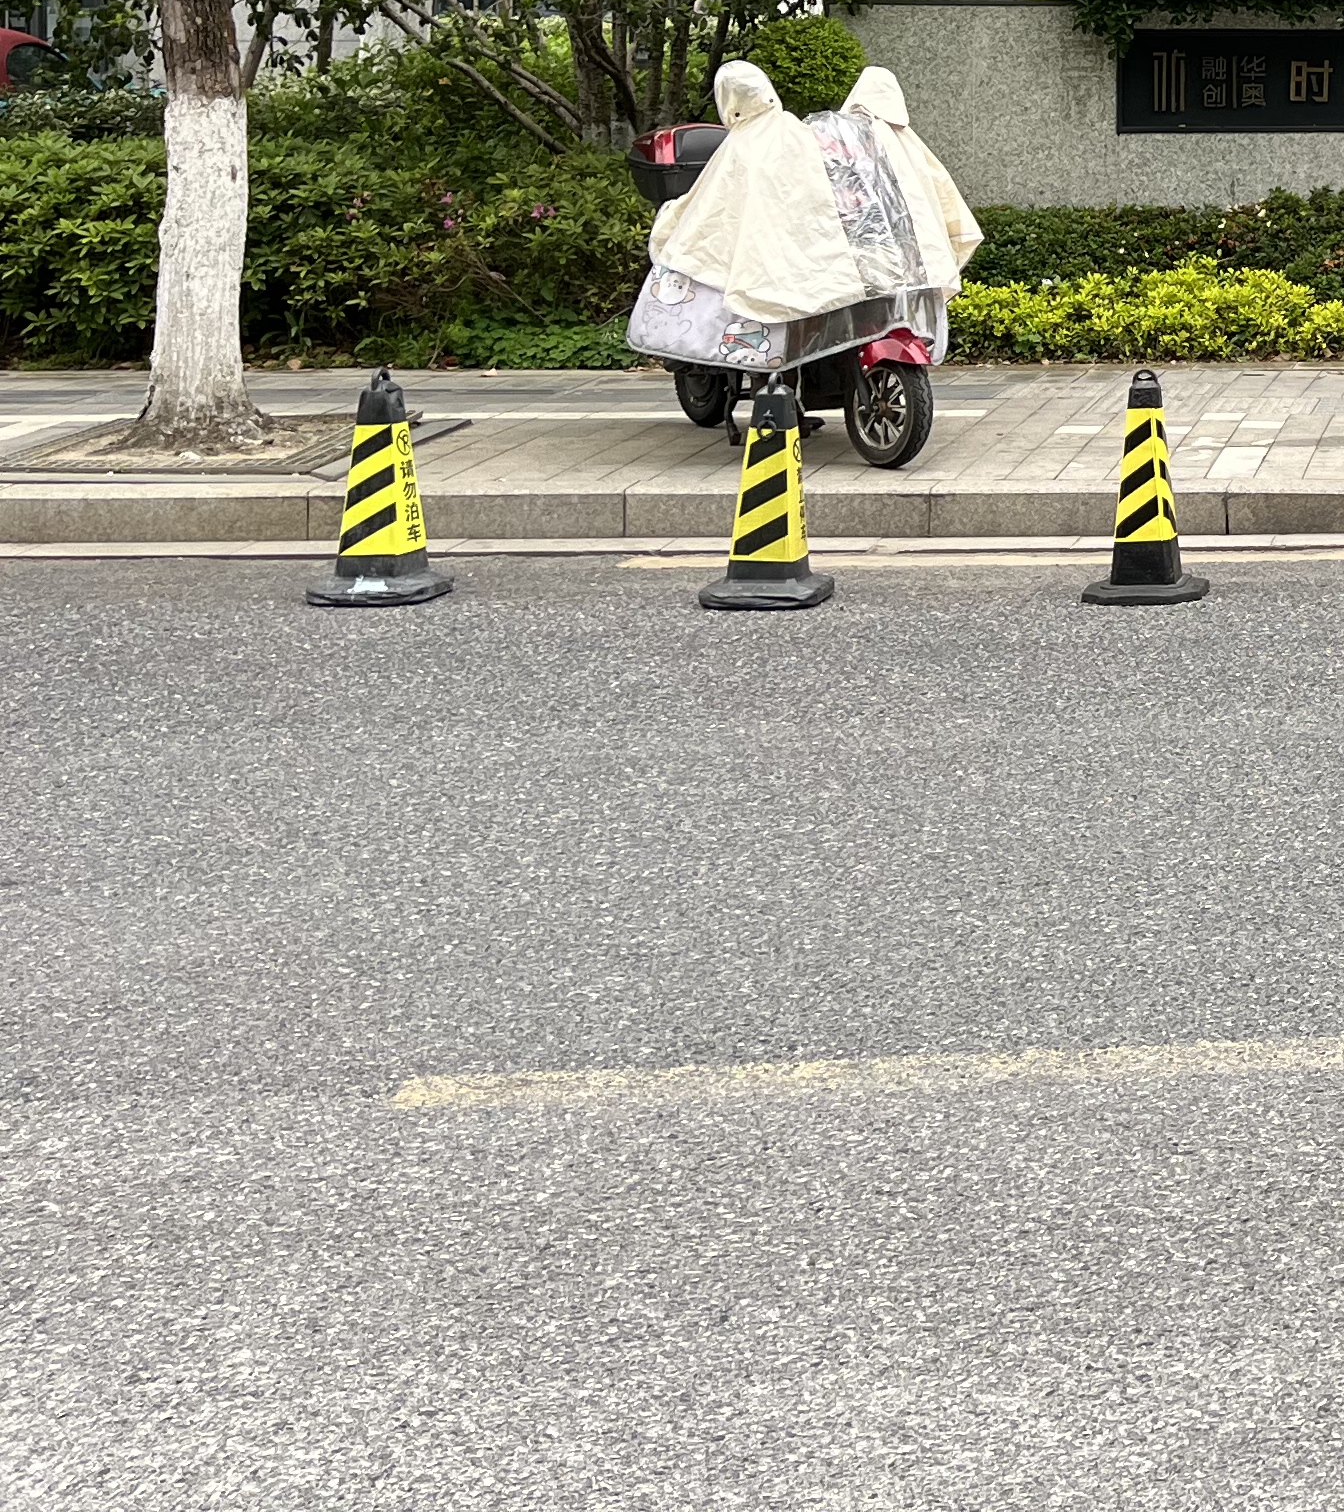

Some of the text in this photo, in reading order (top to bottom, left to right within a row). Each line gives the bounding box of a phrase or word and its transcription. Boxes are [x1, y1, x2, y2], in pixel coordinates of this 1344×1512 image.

[1202, 56, 1227, 107] 融创
[1240, 55, 1266, 107] 华奥
[399, 459, 422, 543] 请勿泊车
